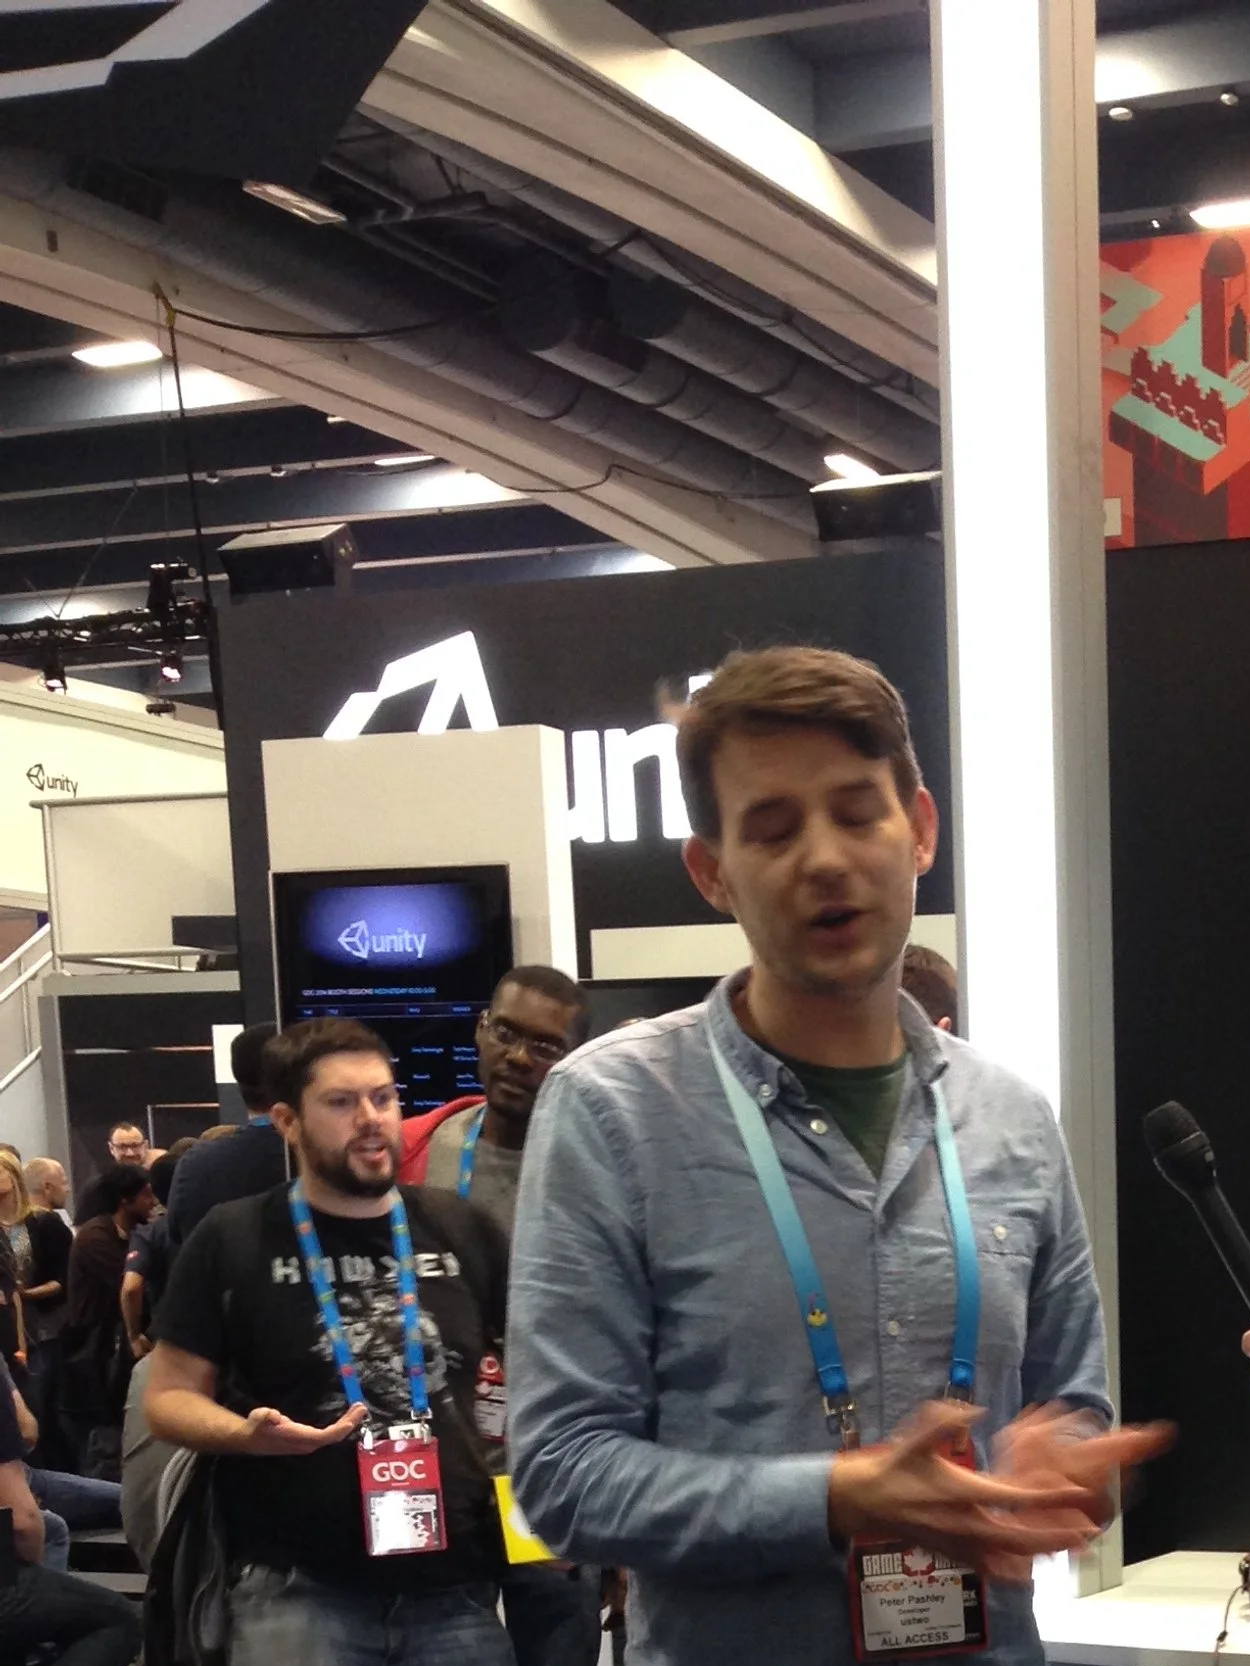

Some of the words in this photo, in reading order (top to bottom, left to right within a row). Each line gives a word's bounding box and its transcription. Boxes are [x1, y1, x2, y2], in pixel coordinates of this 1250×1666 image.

[46, 774, 78, 799] unity
[371, 927, 427, 959] unity
[372, 1459, 427, 1483] GDC
[880, 1597, 905, 1608] Peter
[907, 1593, 946, 1605] Pashley
[900, 1616, 930, 1627] ustwo
[881, 1636, 902, 1647] ALL
[905, 1631, 950, 1645] ACCESS
